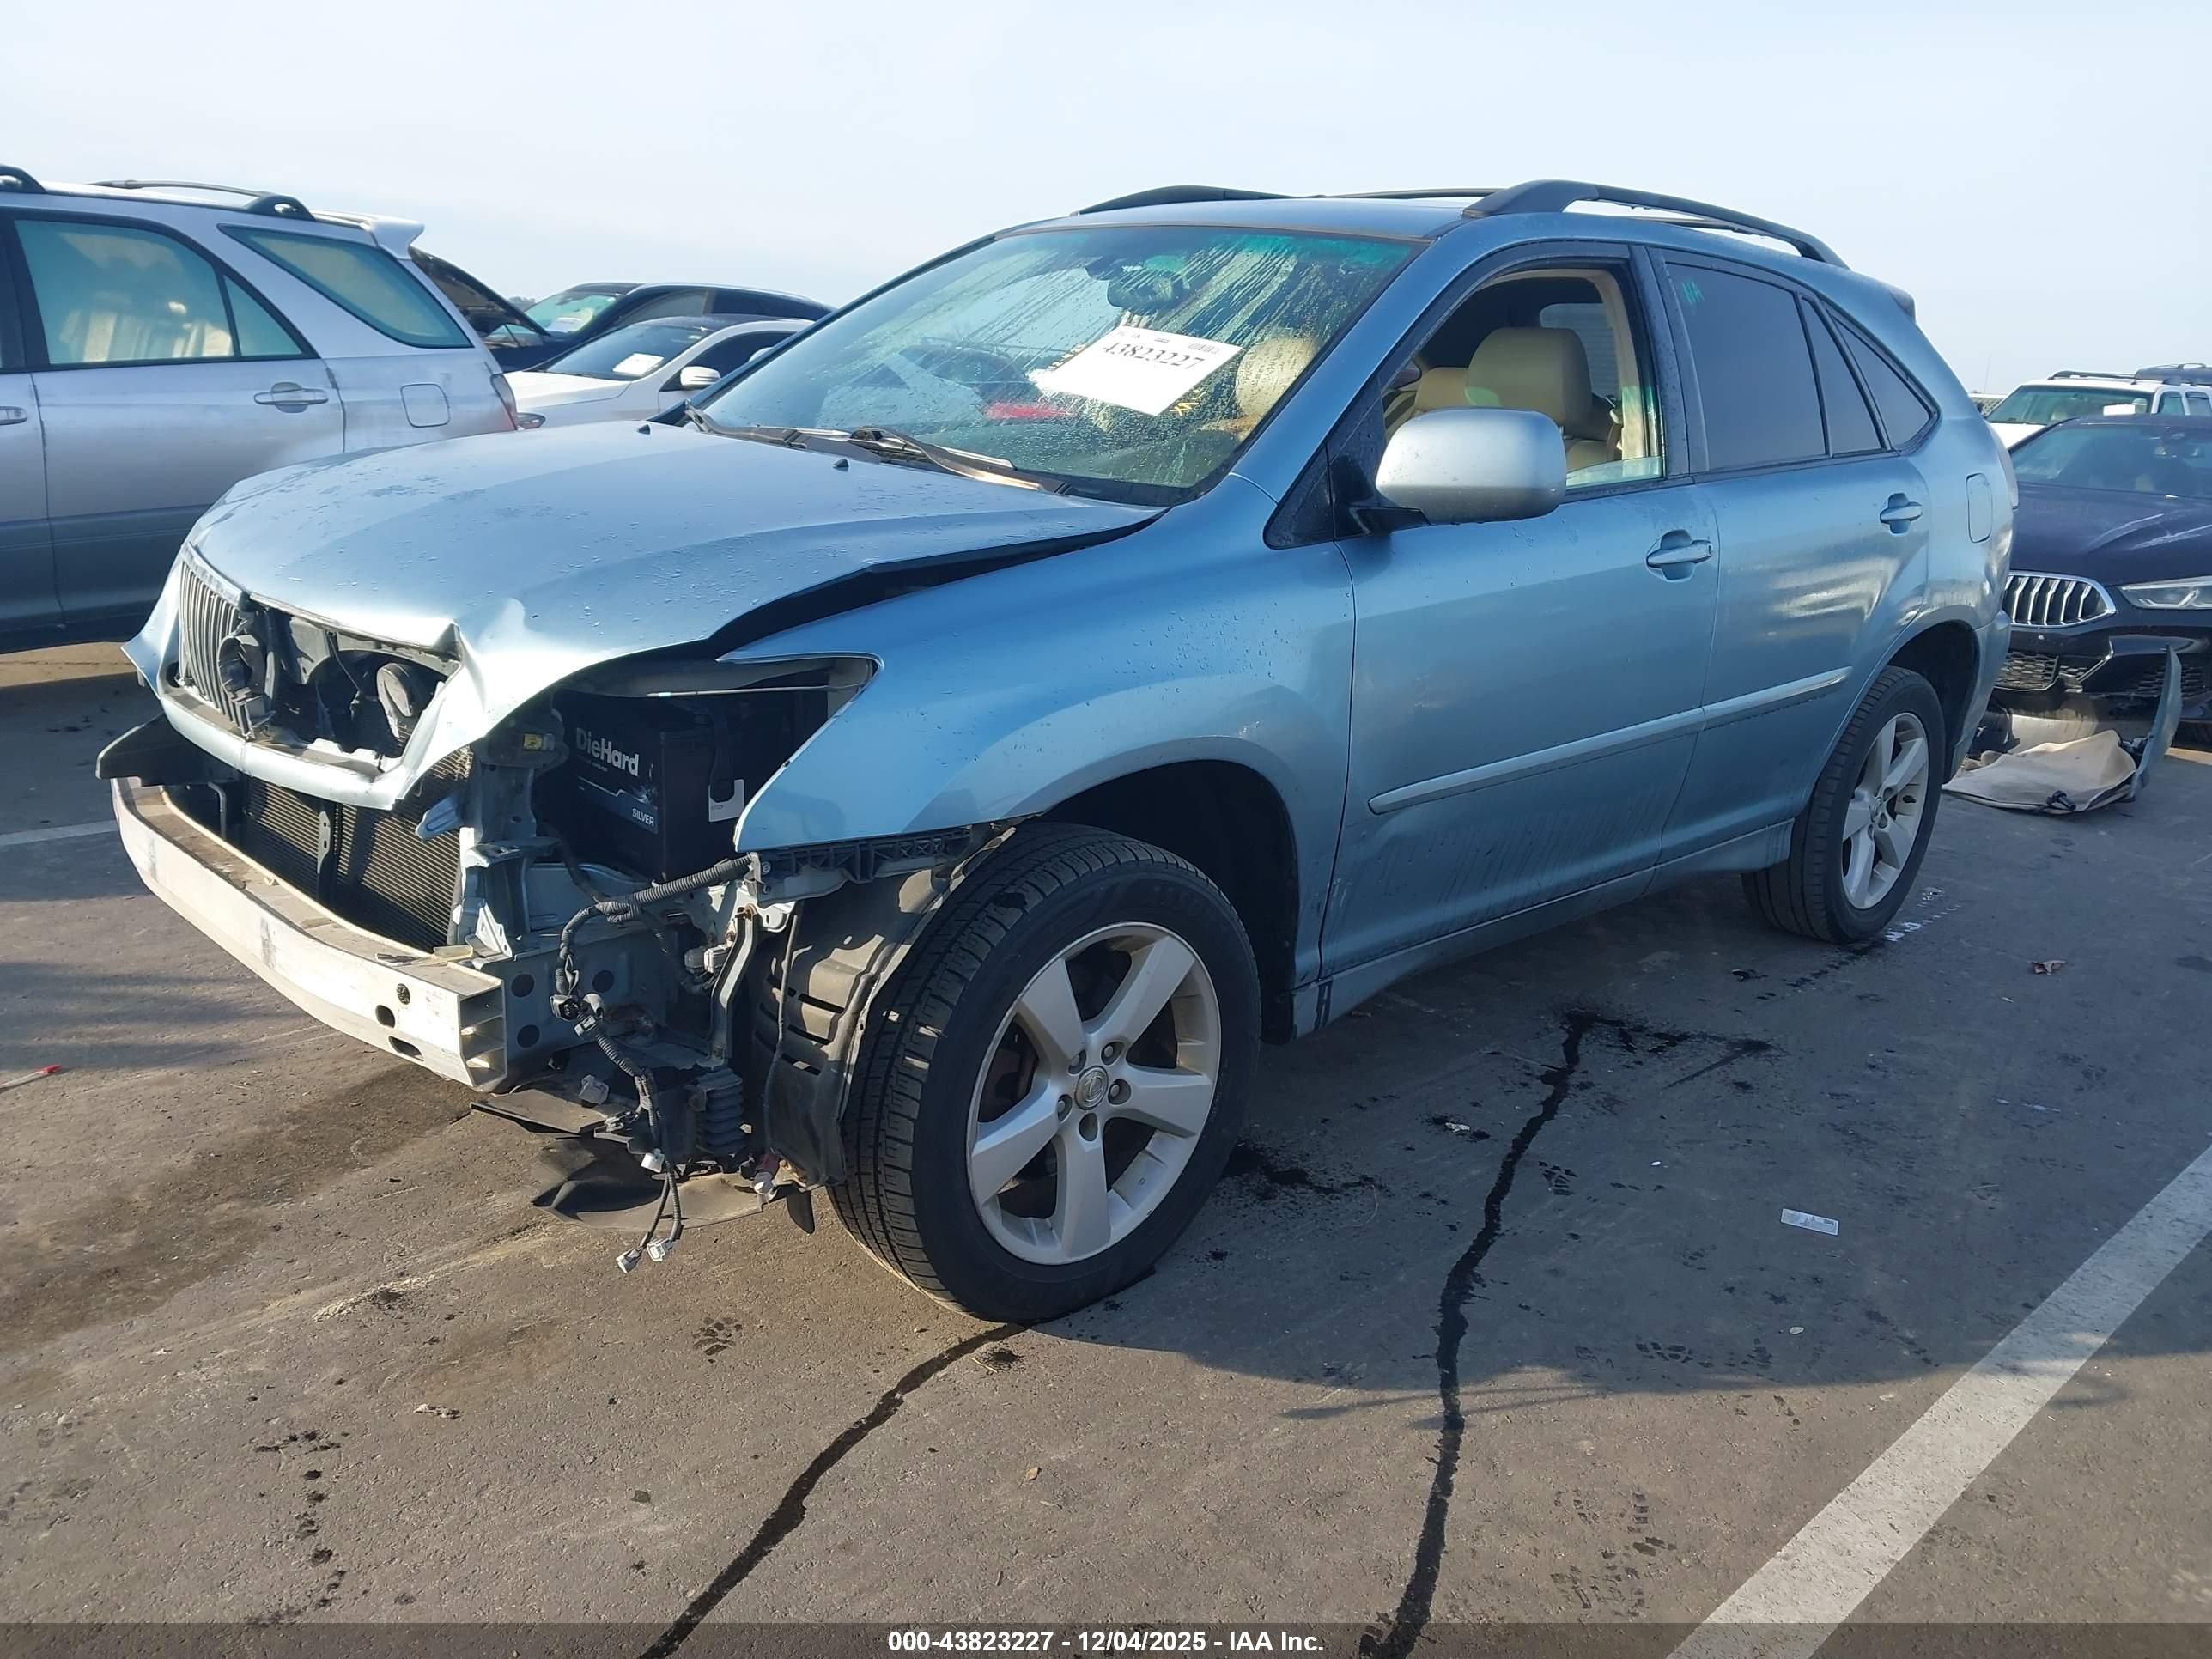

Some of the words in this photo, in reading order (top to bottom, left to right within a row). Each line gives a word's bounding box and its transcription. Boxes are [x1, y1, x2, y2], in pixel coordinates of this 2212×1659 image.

[1103, 341, 1206, 369] 43823227
[576, 727, 640, 777] DieHard
[632, 808, 655, 827] SILVER
